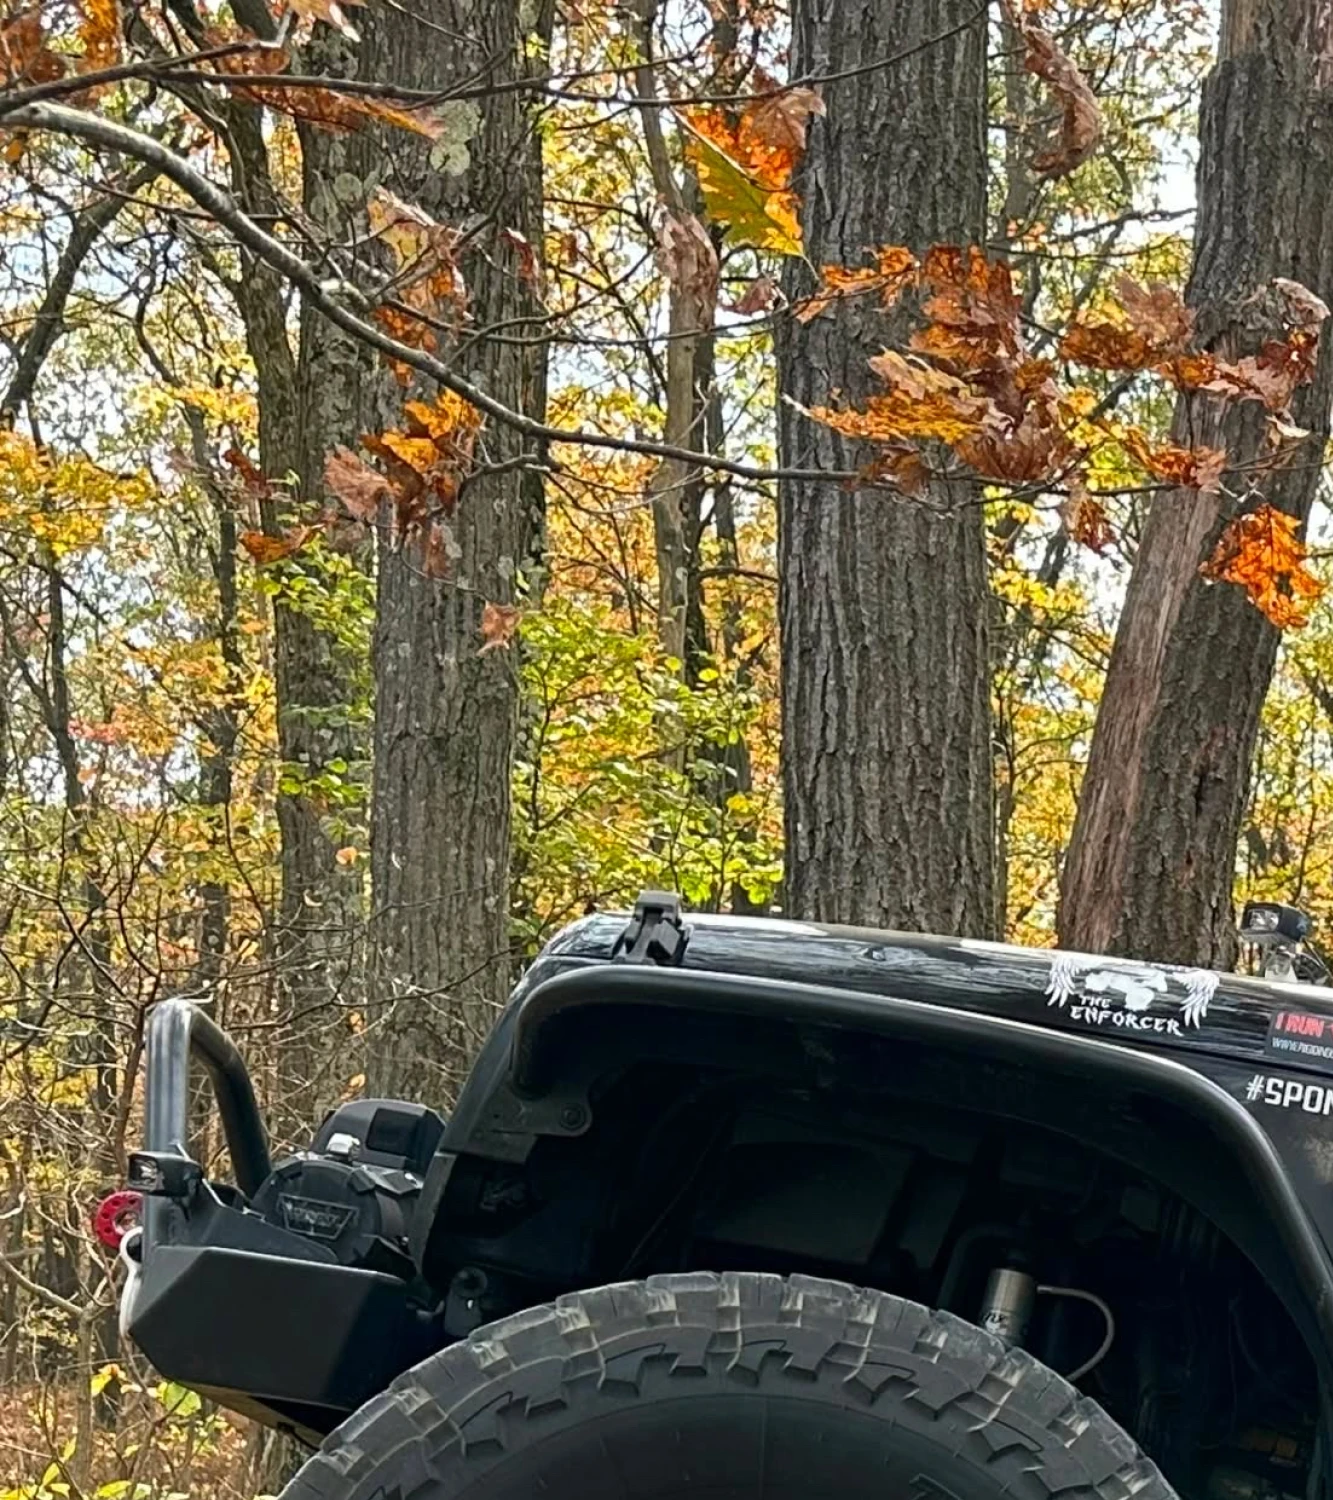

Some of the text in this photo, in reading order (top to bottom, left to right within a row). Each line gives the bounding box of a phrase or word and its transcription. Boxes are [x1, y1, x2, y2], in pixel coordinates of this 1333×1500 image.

[1078, 994, 1113, 1008] THE
[1070, 1006, 1185, 1037] ENFORCER
[1286, 1013, 1324, 1038] RUN
